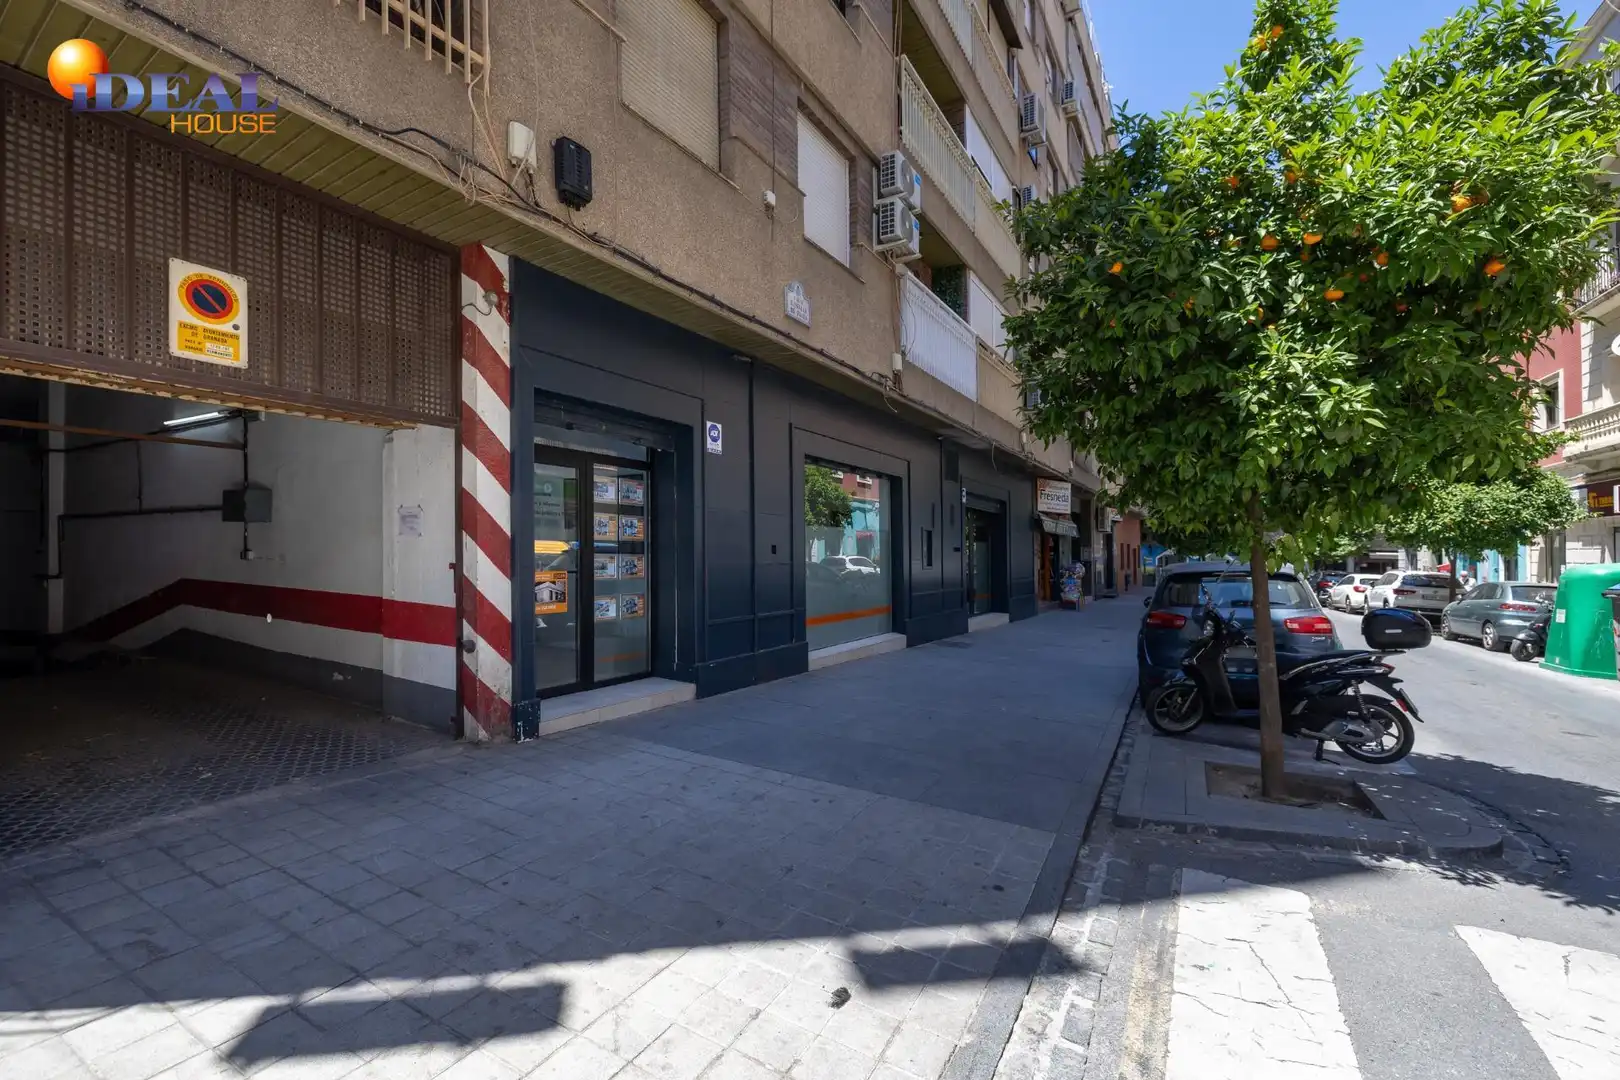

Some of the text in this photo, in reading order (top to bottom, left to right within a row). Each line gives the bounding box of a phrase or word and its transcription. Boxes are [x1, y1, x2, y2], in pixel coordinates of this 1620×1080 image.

[202, 328, 240, 340] AYUNTAMIENTO
[202, 334, 228, 344] GRANADA
[1040, 492, 1069, 502] Fresneda
